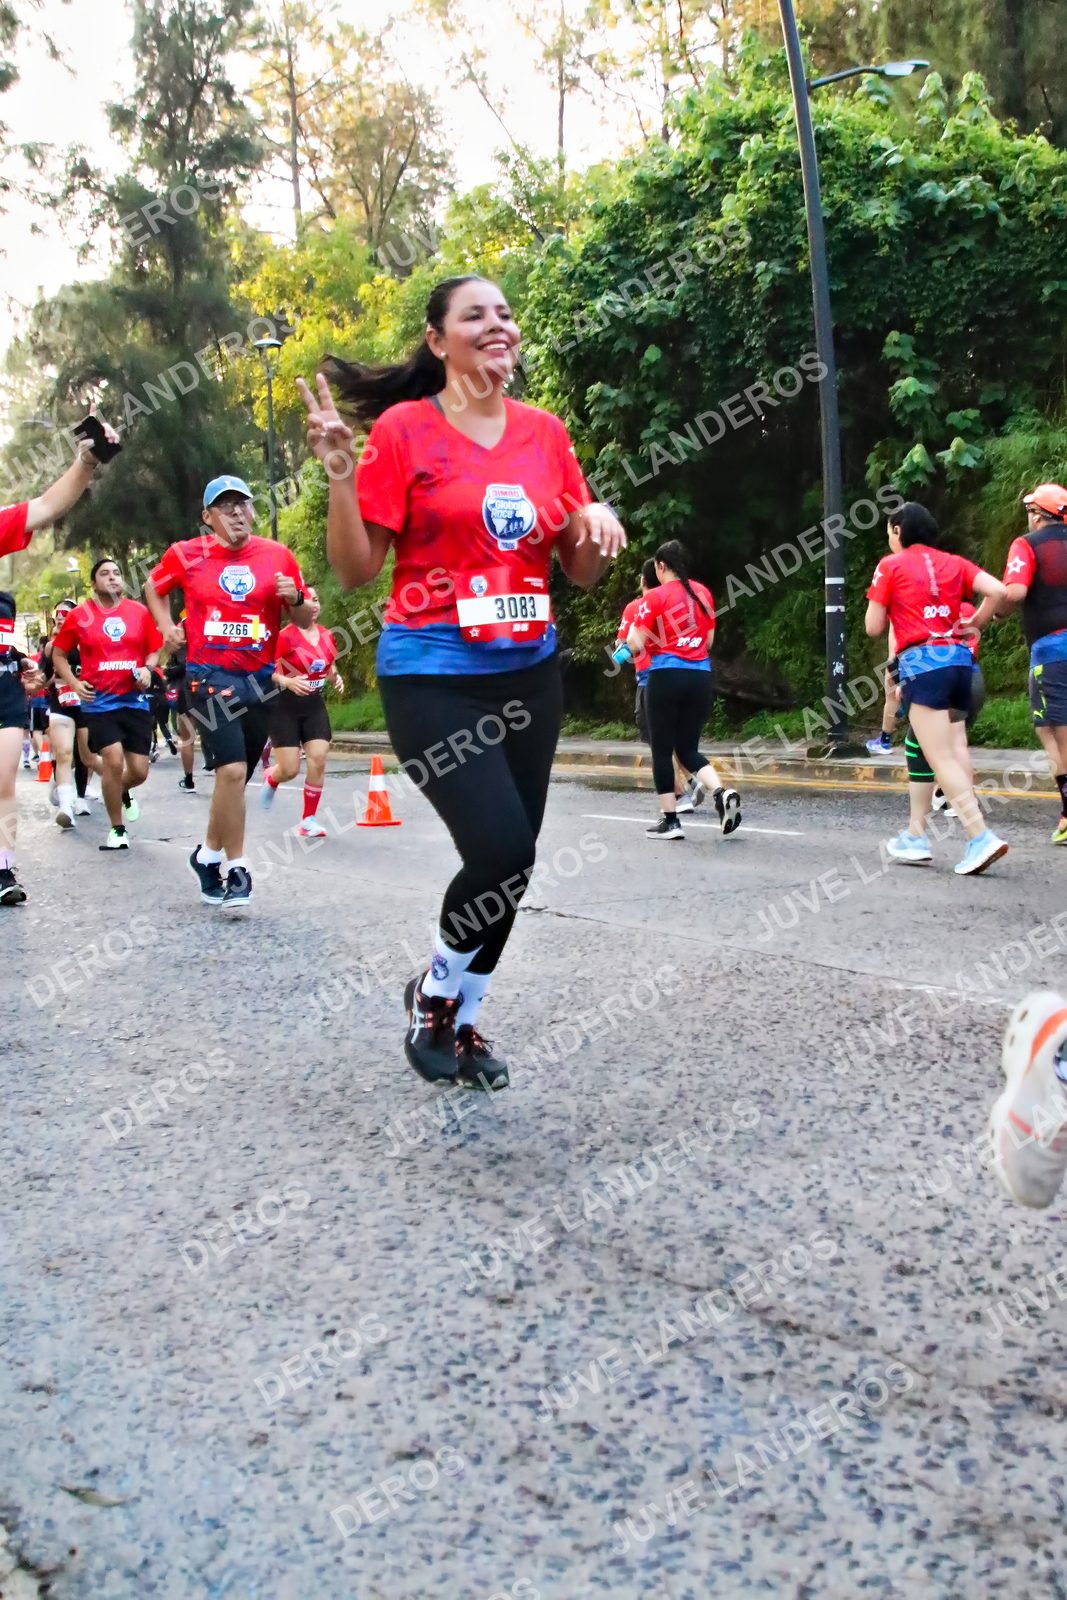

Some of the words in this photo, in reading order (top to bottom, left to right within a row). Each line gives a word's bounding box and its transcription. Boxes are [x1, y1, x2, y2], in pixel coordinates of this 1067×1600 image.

[494, 596, 537, 620] 3083
[222, 623, 249, 636] 2266
[98, 660, 138, 671] SANTIAGO
